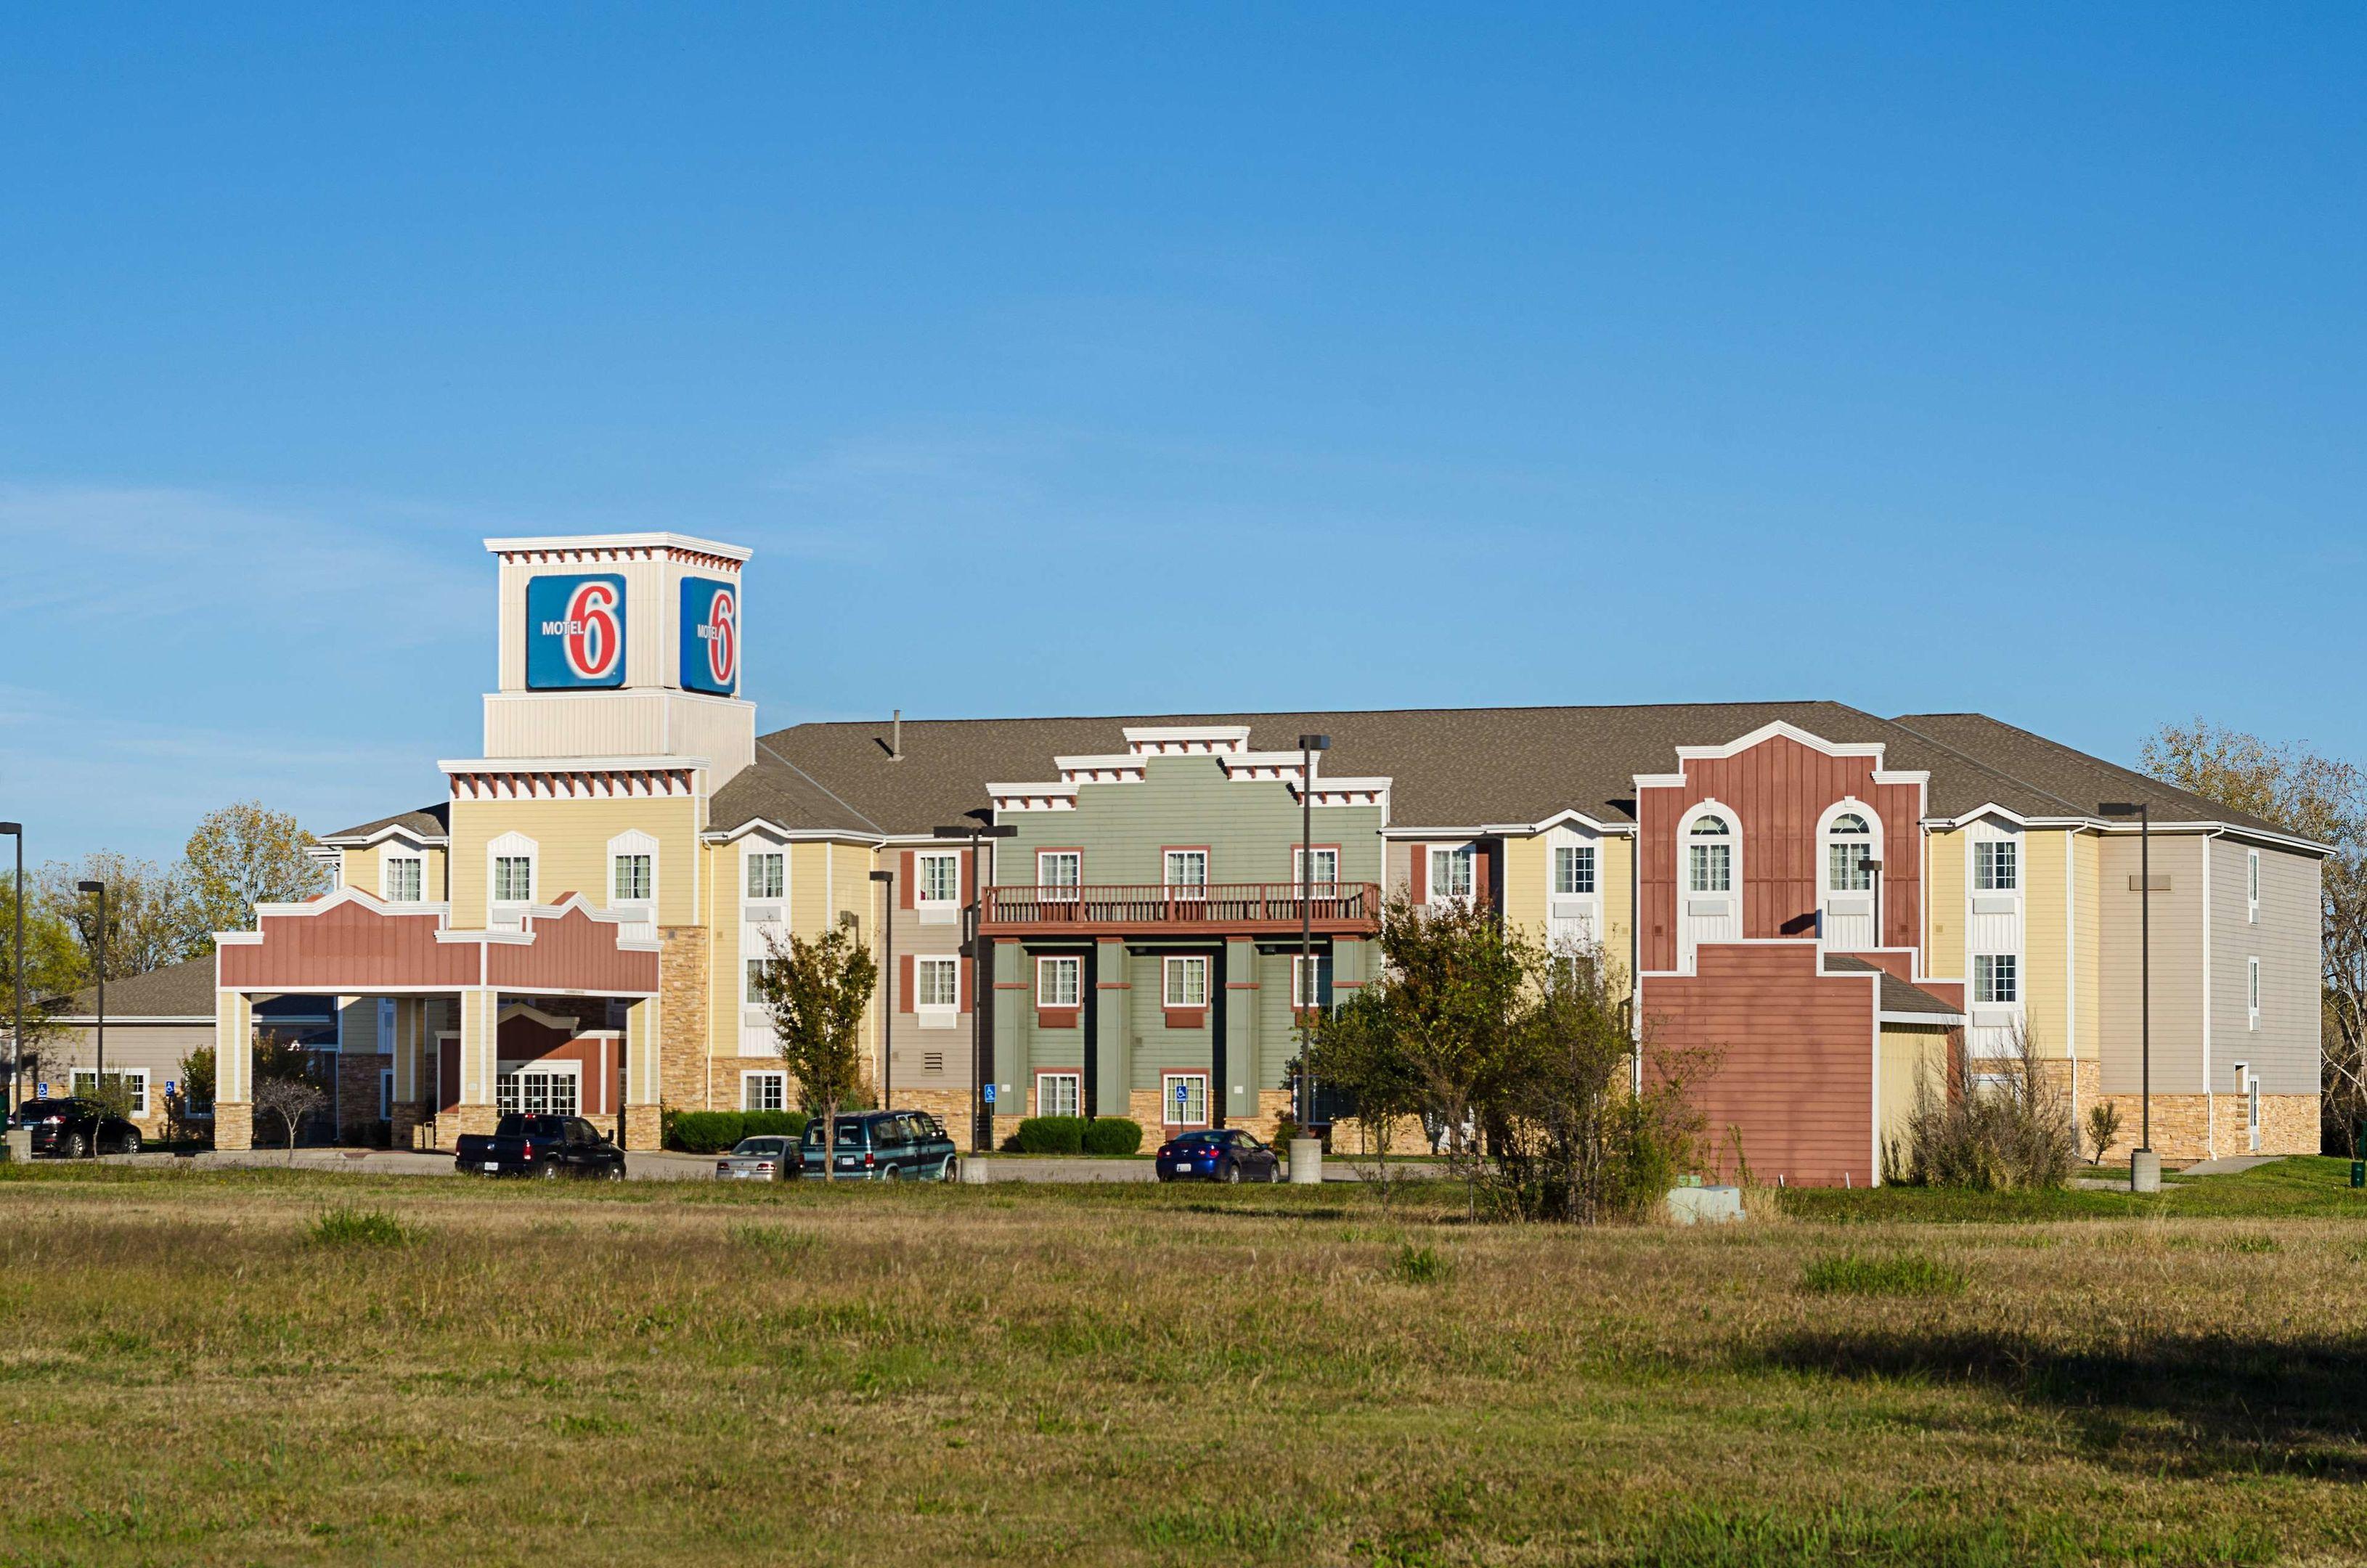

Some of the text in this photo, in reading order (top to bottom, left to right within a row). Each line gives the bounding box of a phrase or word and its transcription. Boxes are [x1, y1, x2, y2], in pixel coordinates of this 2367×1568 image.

[542, 585, 616, 675] MOTEL 6
[697, 592, 733, 682] MOTEL 6
